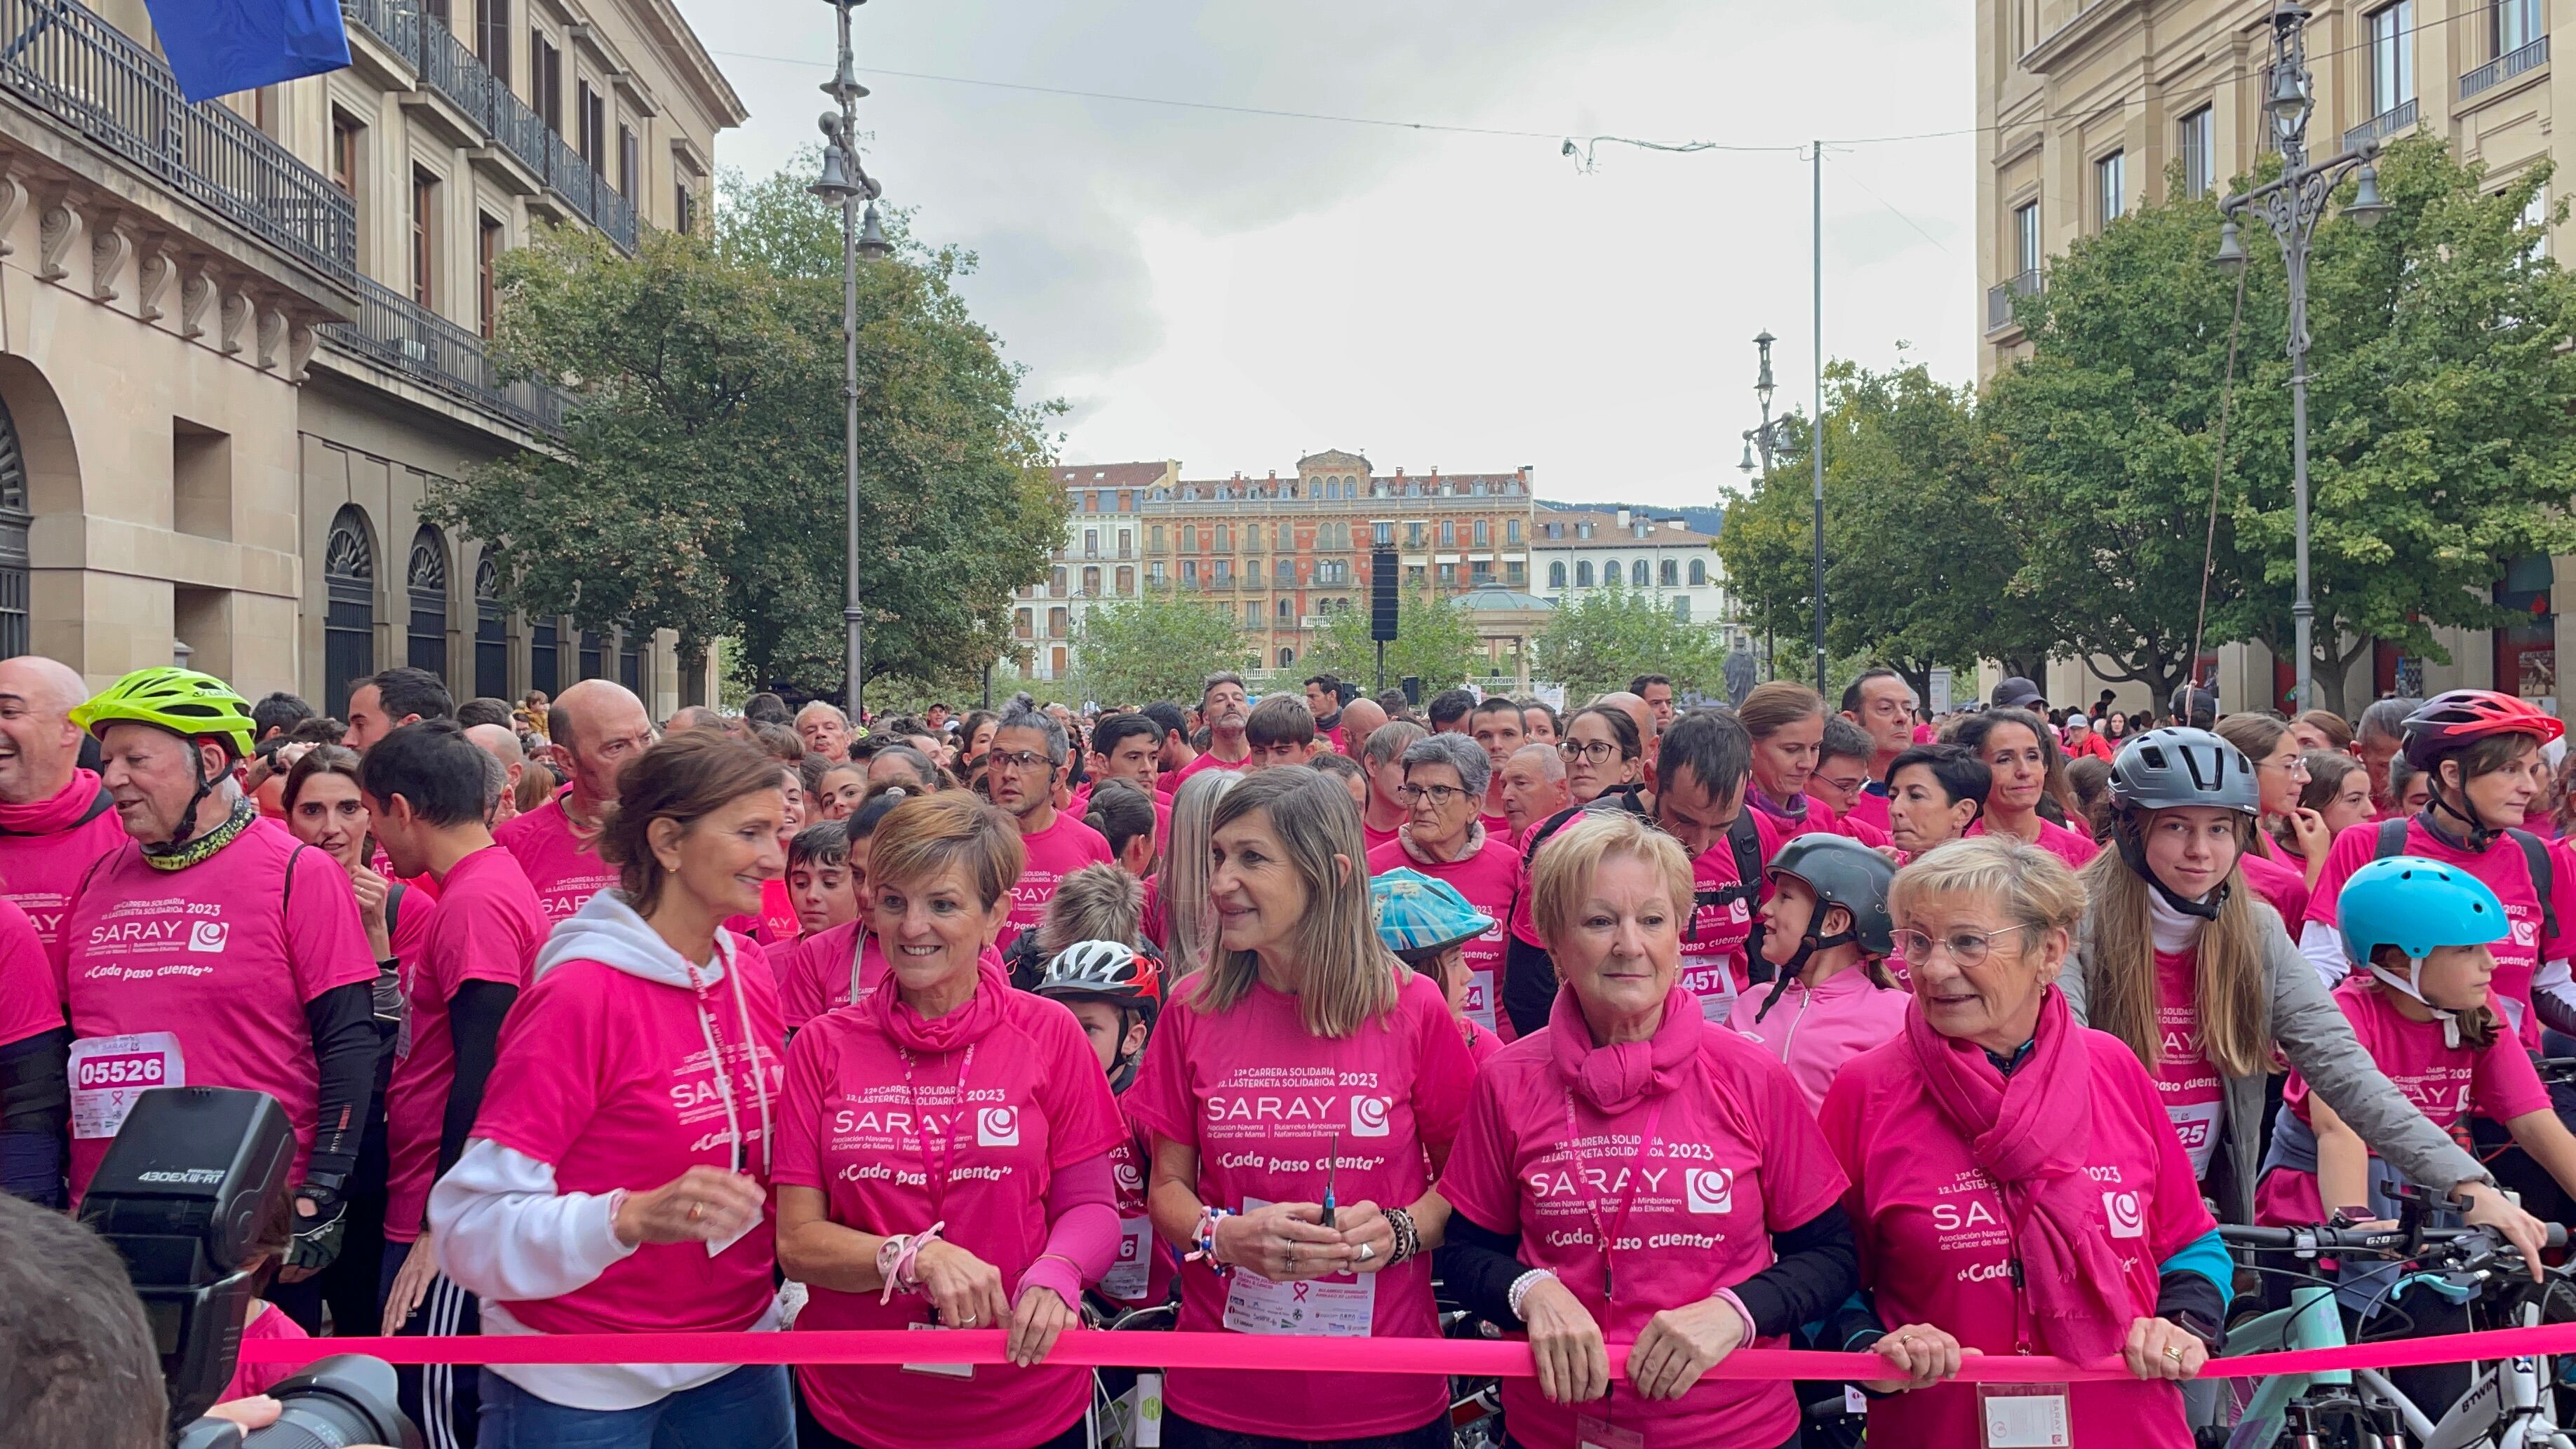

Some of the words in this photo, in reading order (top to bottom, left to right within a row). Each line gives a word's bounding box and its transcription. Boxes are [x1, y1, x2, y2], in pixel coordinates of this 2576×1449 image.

[1010, 887, 1052, 901] RAY
[186, 903, 221, 917] 2023
[89, 920, 182, 944] SARAY
[123, 967, 153, 981] paso
[1682, 970, 1719, 992] 457
[965, 1043, 976, 1066] SARA
[80, 1058, 162, 1084] 05526
[1249, 1067, 1289, 1077] CARRERA
[1289, 1067, 1336, 1077] SOLIDARIA
[2449, 1068, 2471, 1079] 202
[1228, 1078, 1281, 1088] LASTERKETA
[1282, 1078, 1336, 1087] SOLIDARIOA
[1339, 1072, 1378, 1089] 2023
[857, 1094, 910, 1105] LASTERKETA
[911, 1096, 964, 1106] OLIDARIOA
[966, 1089, 1005, 1102] 2023
[1206, 1096, 1336, 1121] SARAY
[1668, 1143, 1714, 1161] 2023
[1216, 1151, 1264, 1168] “Cada
[1268, 1157, 1310, 1174] paso
[838, 1162, 891, 1182] “Cada
[895, 1170, 927, 1186] pas
[2081, 1166, 2122, 1183] 023
[1529, 1166, 1668, 1198] SARAY
[1637, 1197, 1682, 1206] Minbiziaren
[1644, 1205, 1675, 1213] Elkartea
[1570, 1206, 1588, 1215] Mam
[1545, 1227, 1594, 1246] “Cada
[1649, 1232, 1725, 1249] cuenta”
[1938, 1232, 1981, 1243] Asociación
[1940, 1242, 1951, 1251] de
[1952, 1239, 1979, 1250] Cáncer
[2053, 1399, 2062, 1431] SARAY
